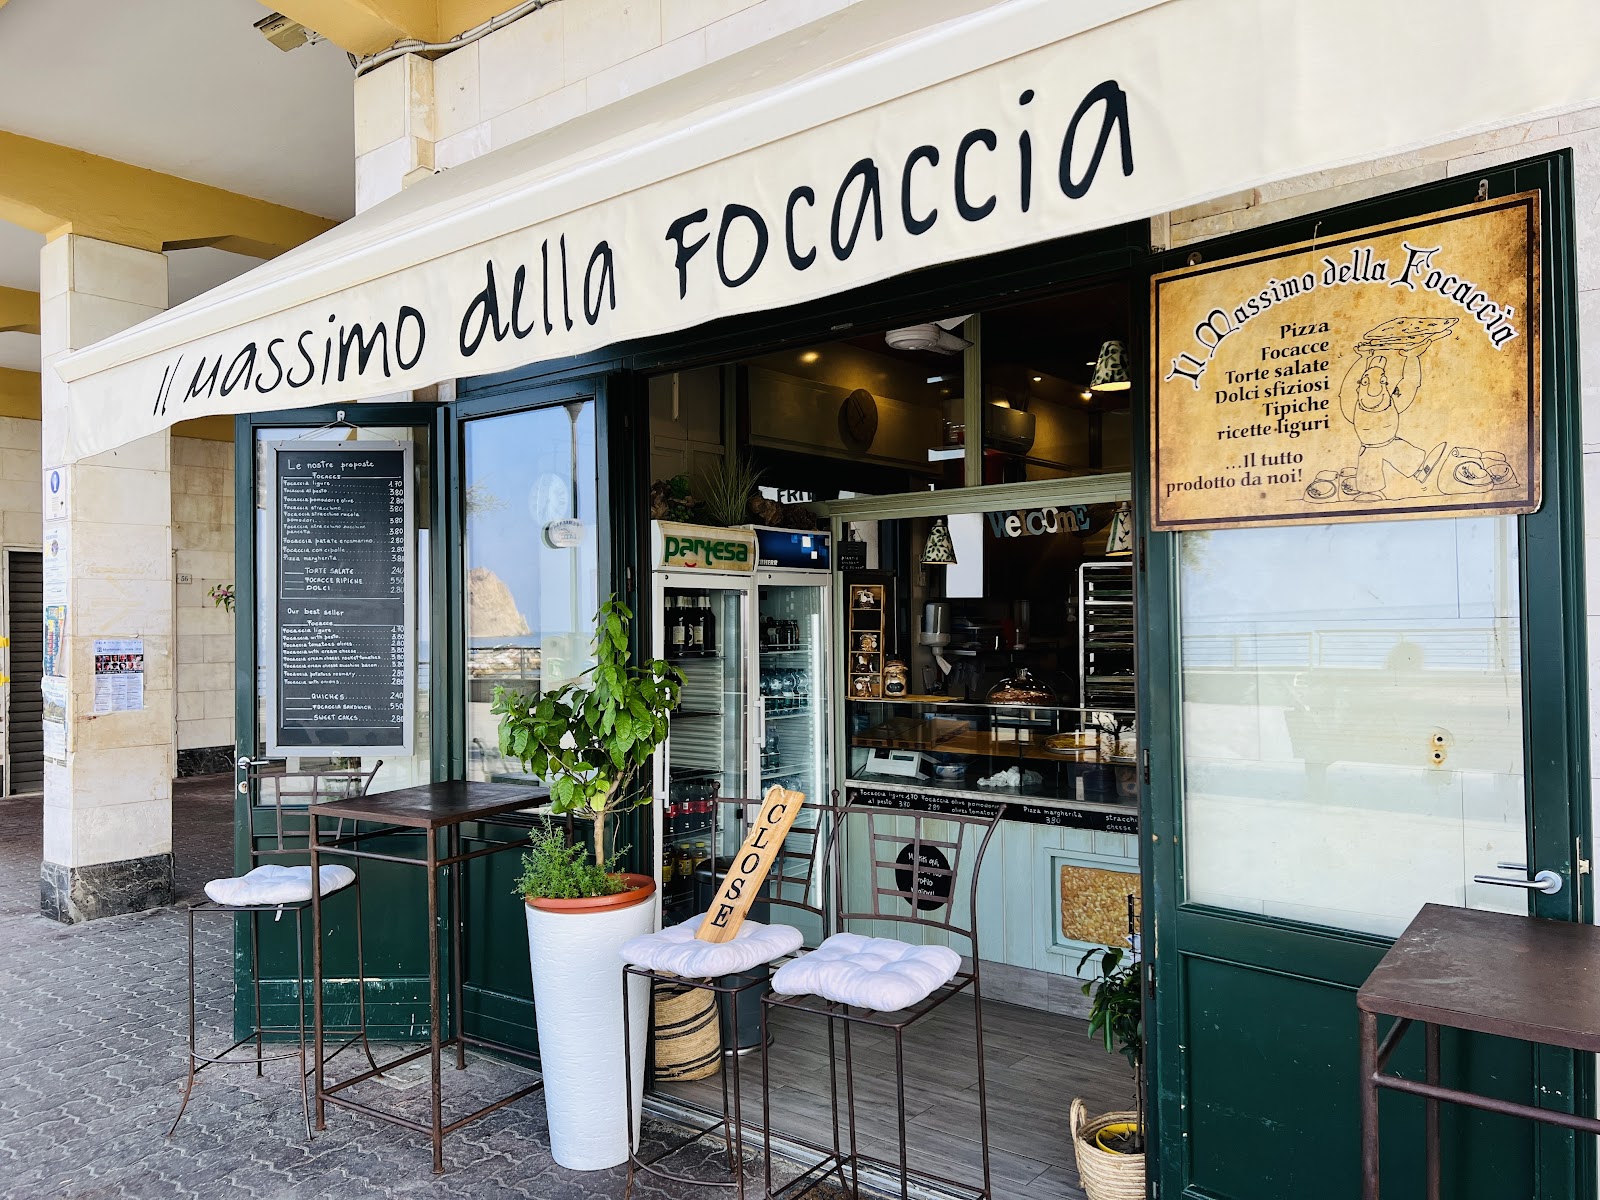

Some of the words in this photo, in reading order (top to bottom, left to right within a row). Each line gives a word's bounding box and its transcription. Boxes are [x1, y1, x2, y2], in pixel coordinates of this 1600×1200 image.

[153, 355, 184, 416] Il
[459, 233, 616, 357] della
[1166, 353, 1206, 388] Il
[1195, 271, 1315, 357] Massimo
[1322, 248, 1386, 288] della
[1391, 242, 1518, 349] Focaccia
[1280, 320, 1330, 339] Pizza
[1261, 341, 1330, 361] Focacce
[1225, 367, 1269, 384] Torte
[1274, 358, 1330, 377] salate
[1215, 386, 1259, 405] Dolci
[1264, 378, 1330, 399] sfiziosi
[1262, 398, 1330, 420] Tipiche
[1216, 422, 1271, 440] ricette
[1277, 417, 1330, 438] liguri
[287, 459, 302, 470] Le
[307, 460, 334, 469] nostre
[340, 460, 375, 471] proposte
[1261, 451, 1303, 468] tutto
[1166, 475, 1237, 498] prodotto
[1240, 472, 1262, 488] da
[1266, 468, 1303, 485] noi!
[664, 536, 748, 566] partesa
[1023, 806, 1042, 814] Pizza
[1044, 809, 1083, 818] margherita
[710, 803, 787, 928] CLOSE
